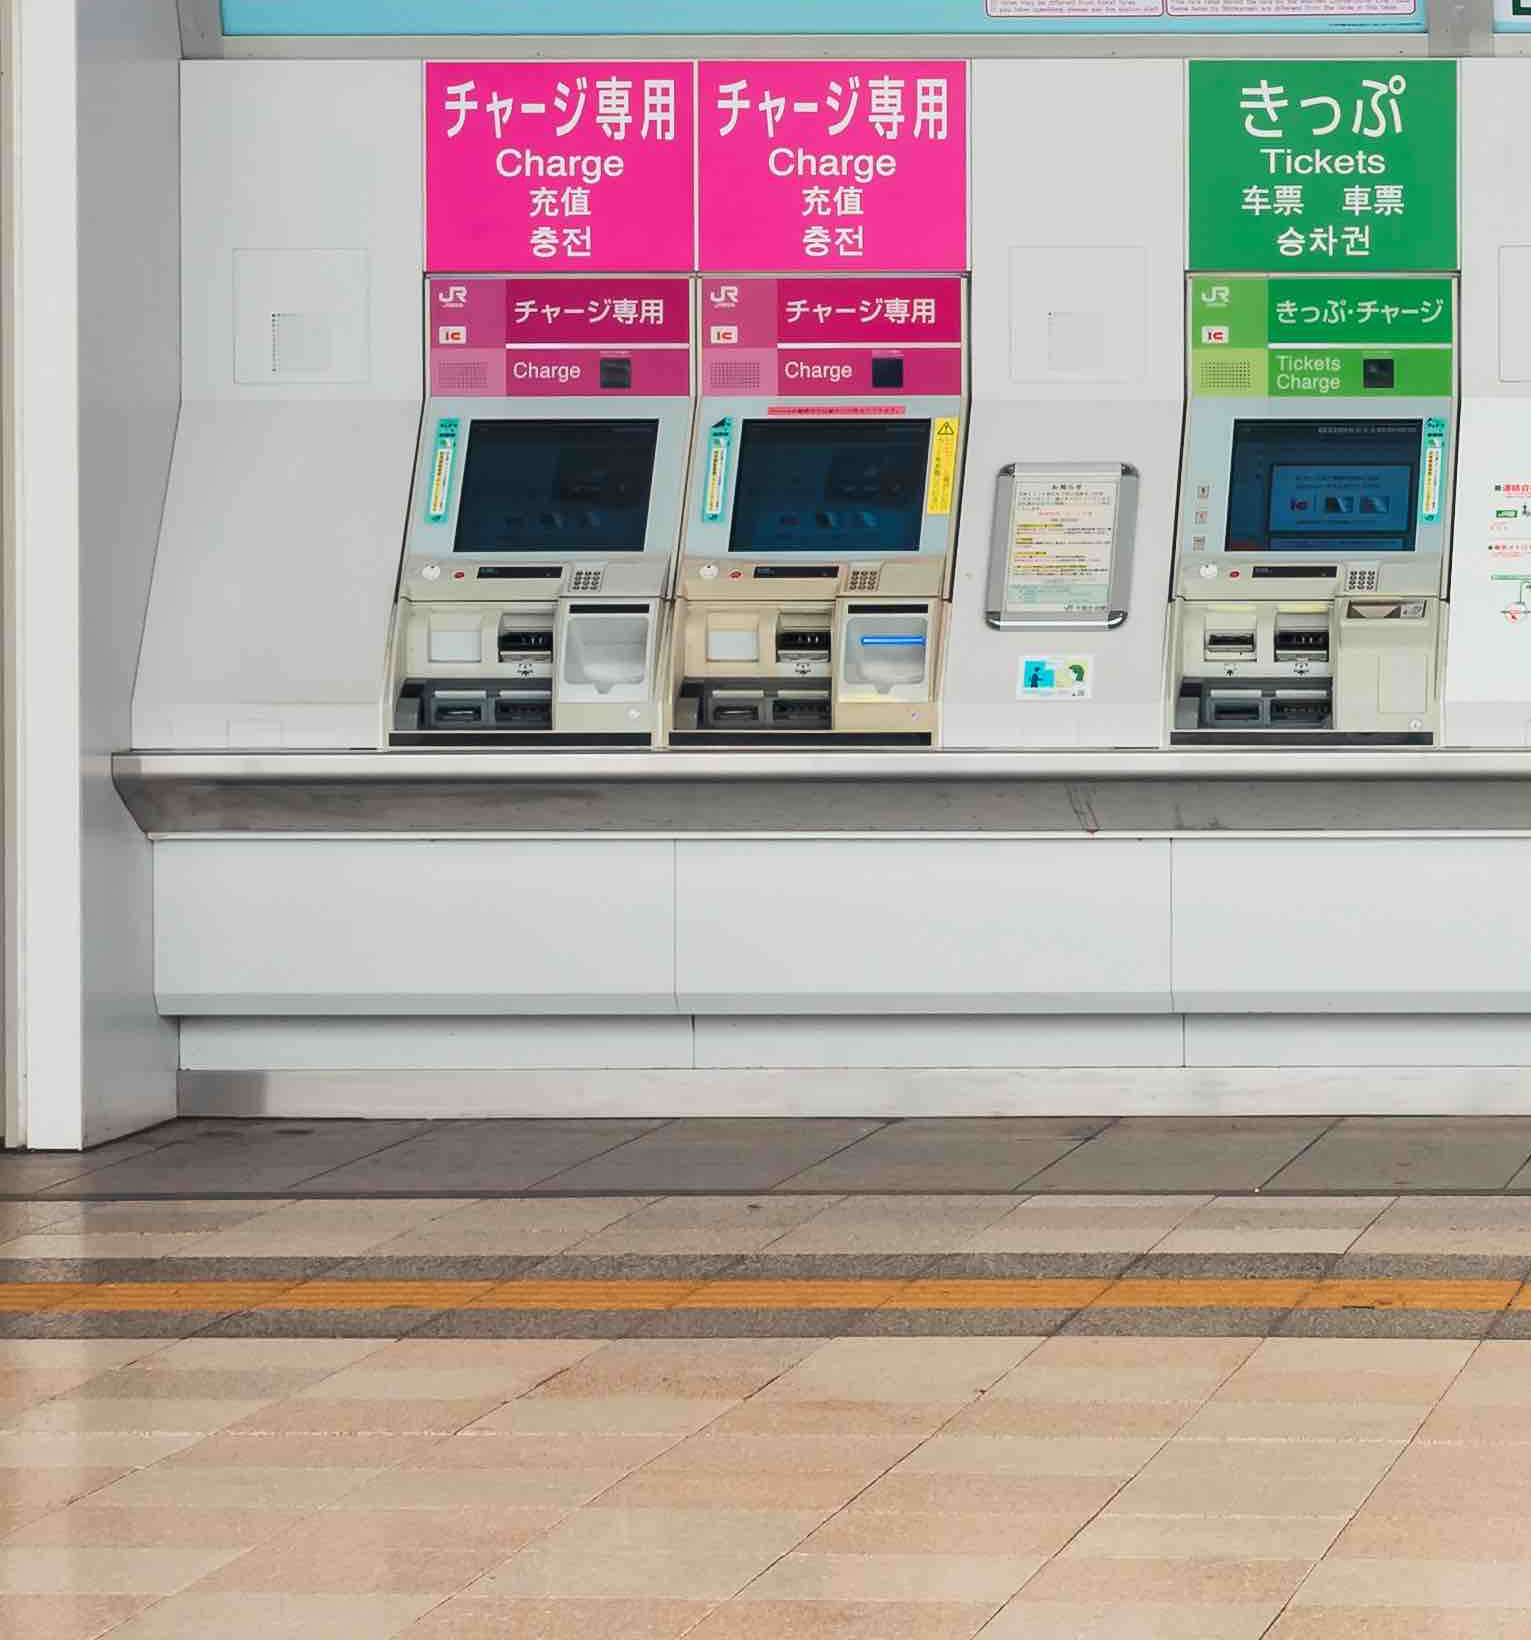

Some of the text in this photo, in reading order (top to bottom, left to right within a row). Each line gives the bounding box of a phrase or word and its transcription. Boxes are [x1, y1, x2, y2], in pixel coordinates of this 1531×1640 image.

[444, 76, 675, 140] チャージ専用
[717, 76, 948, 140] チャージ専用
[1240, 75, 1406, 138] きっぷ
[496, 150, 624, 183] Charge
[768, 150, 896, 183] Charge
[1260, 149, 1385, 174] Tickets
[529, 187, 592, 217] 充值
[801, 187, 864, 217] 充值
[1241, 185, 1404, 215] 车票 車票
[529, 227, 592, 256] 충전
[801, 227, 864, 256] 충전
[1277, 226, 1371, 256] 승차권
[439, 286, 468, 303] JR
[711, 286, 740, 303] JR
[1202, 286, 1230, 302] JR
[513, 299, 664, 325] チャージ専用
[785, 299, 936, 325] チャージ専用
[513, 362, 580, 381] Charge
[785, 362, 853, 381] Charge
[1276, 356, 1341, 371] Tickets
[1276, 374, 1340, 391] Charge
